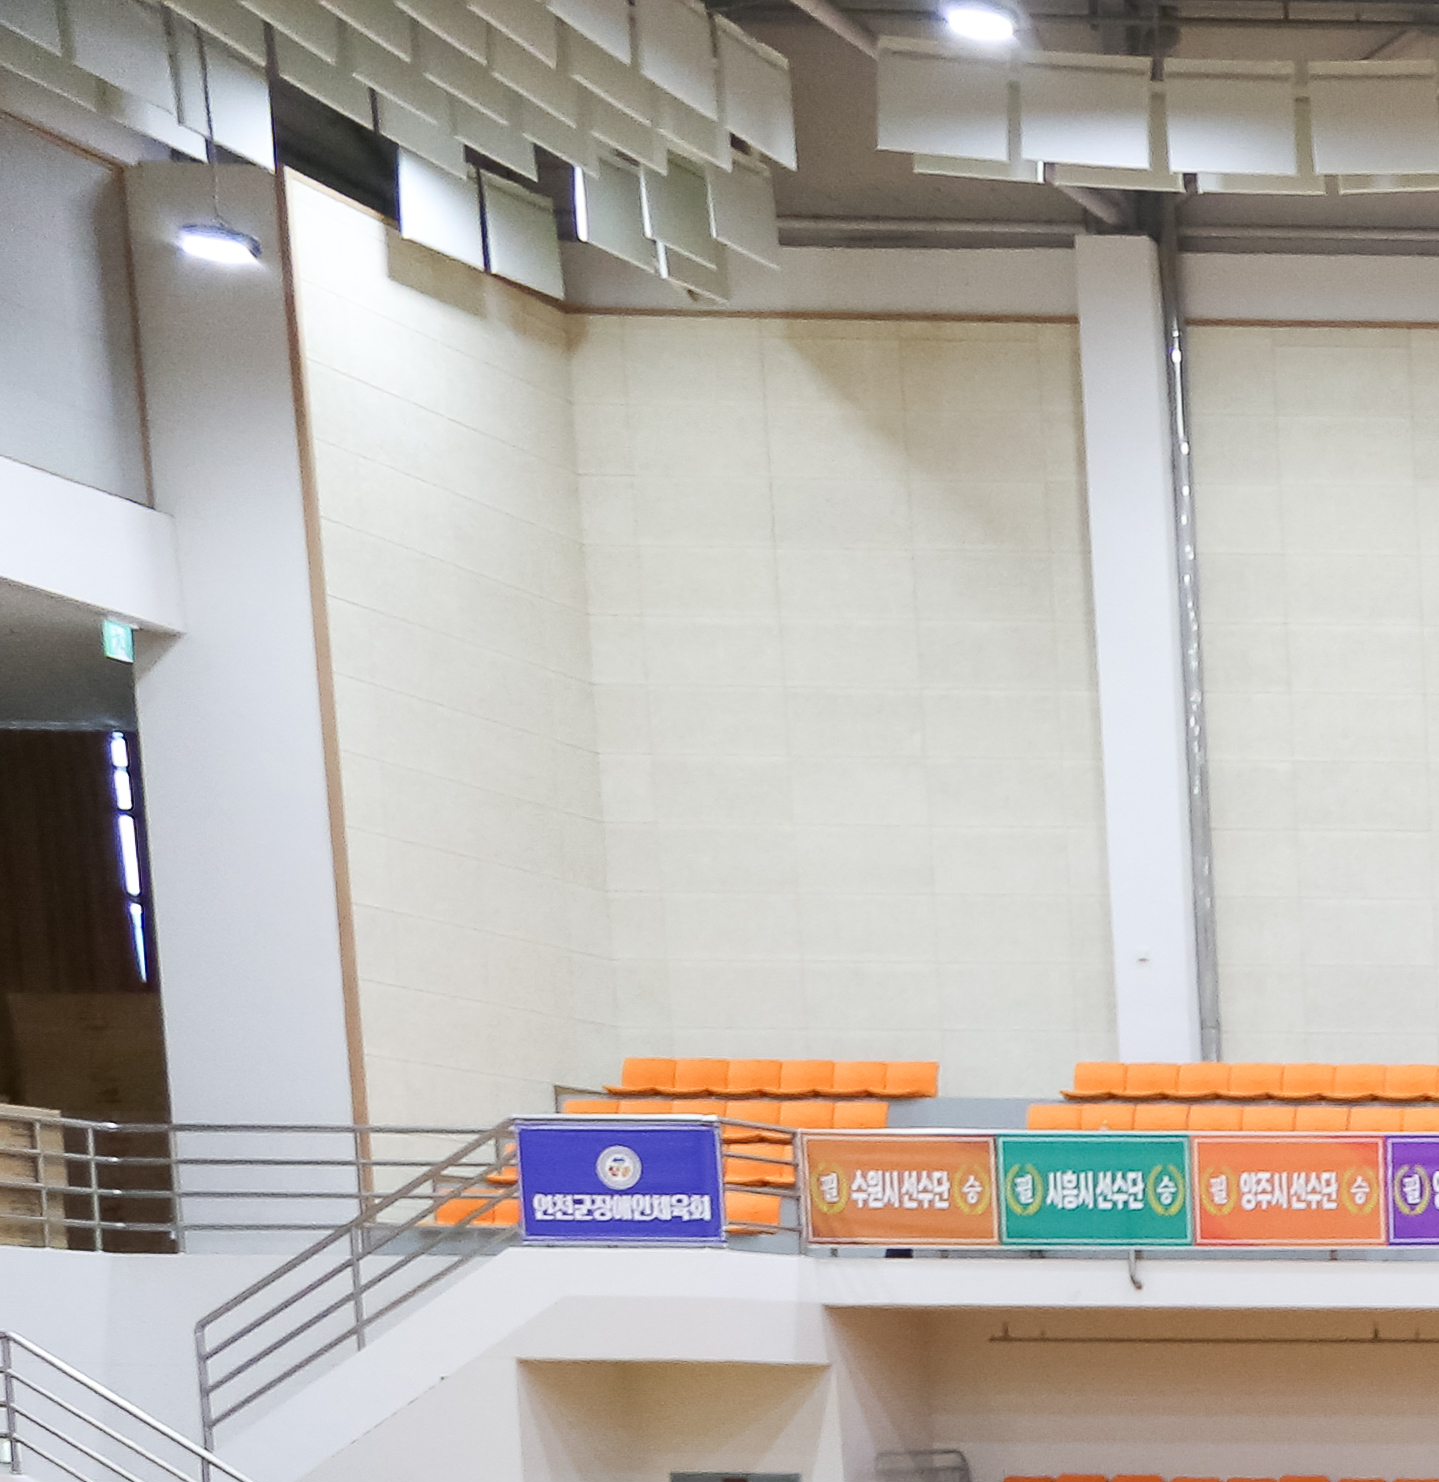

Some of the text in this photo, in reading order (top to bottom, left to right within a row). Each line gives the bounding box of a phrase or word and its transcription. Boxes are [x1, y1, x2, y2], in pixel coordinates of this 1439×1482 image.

[533, 1193, 712, 1221] 연천군장애인체육회
[820, 1169, 983, 1210] 필 수원시 선수단 승
[1014, 1169, 1178, 1210] 필 시흥시 선수단 승
[1209, 1171, 1370, 1211] 필 양주시 선수단 승
[1402, 1173, 1421, 1204] 필
